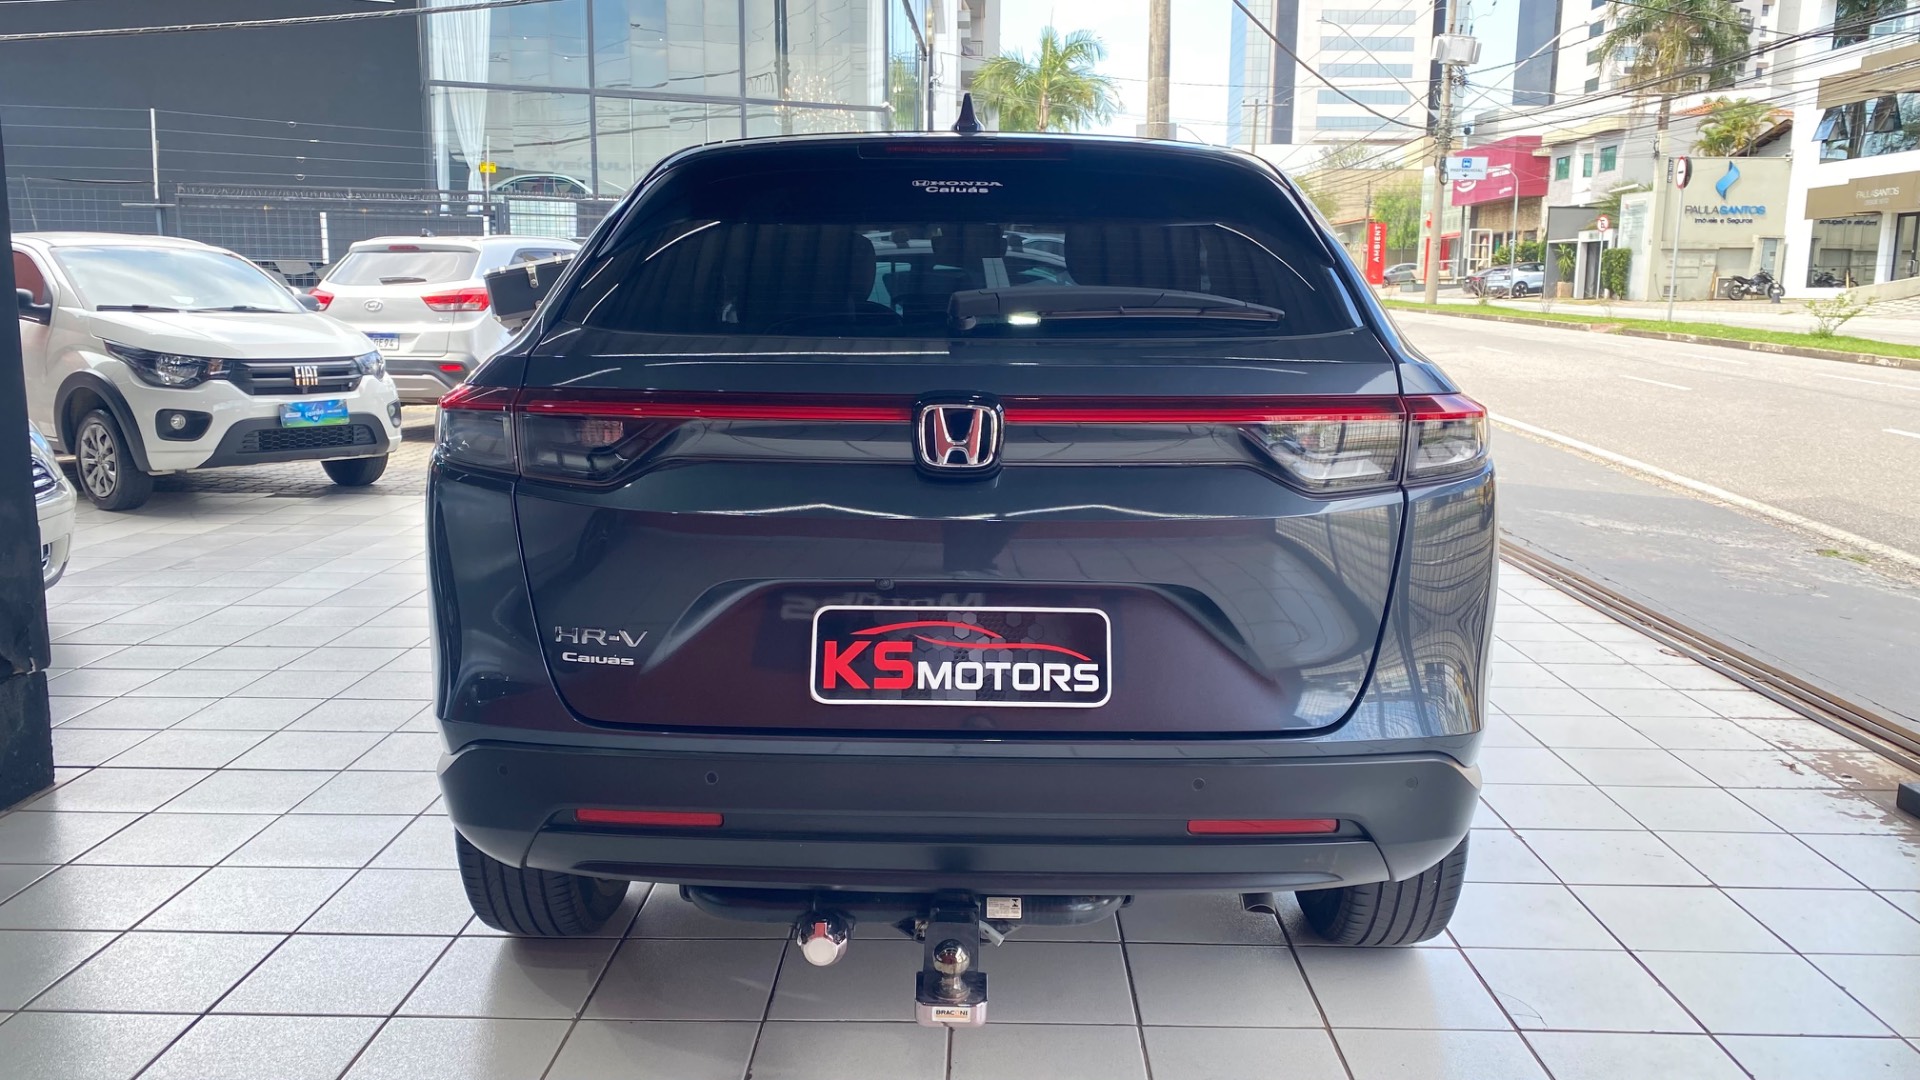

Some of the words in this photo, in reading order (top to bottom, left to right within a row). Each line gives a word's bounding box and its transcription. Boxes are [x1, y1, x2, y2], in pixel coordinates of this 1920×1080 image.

[294, 365, 319, 386] FIAT
[554, 626, 648, 648] HR-V
[562, 651, 635, 666] Caiuás
[823, 640, 914, 690] KS
[917, 661, 1100, 692] MOTORS
